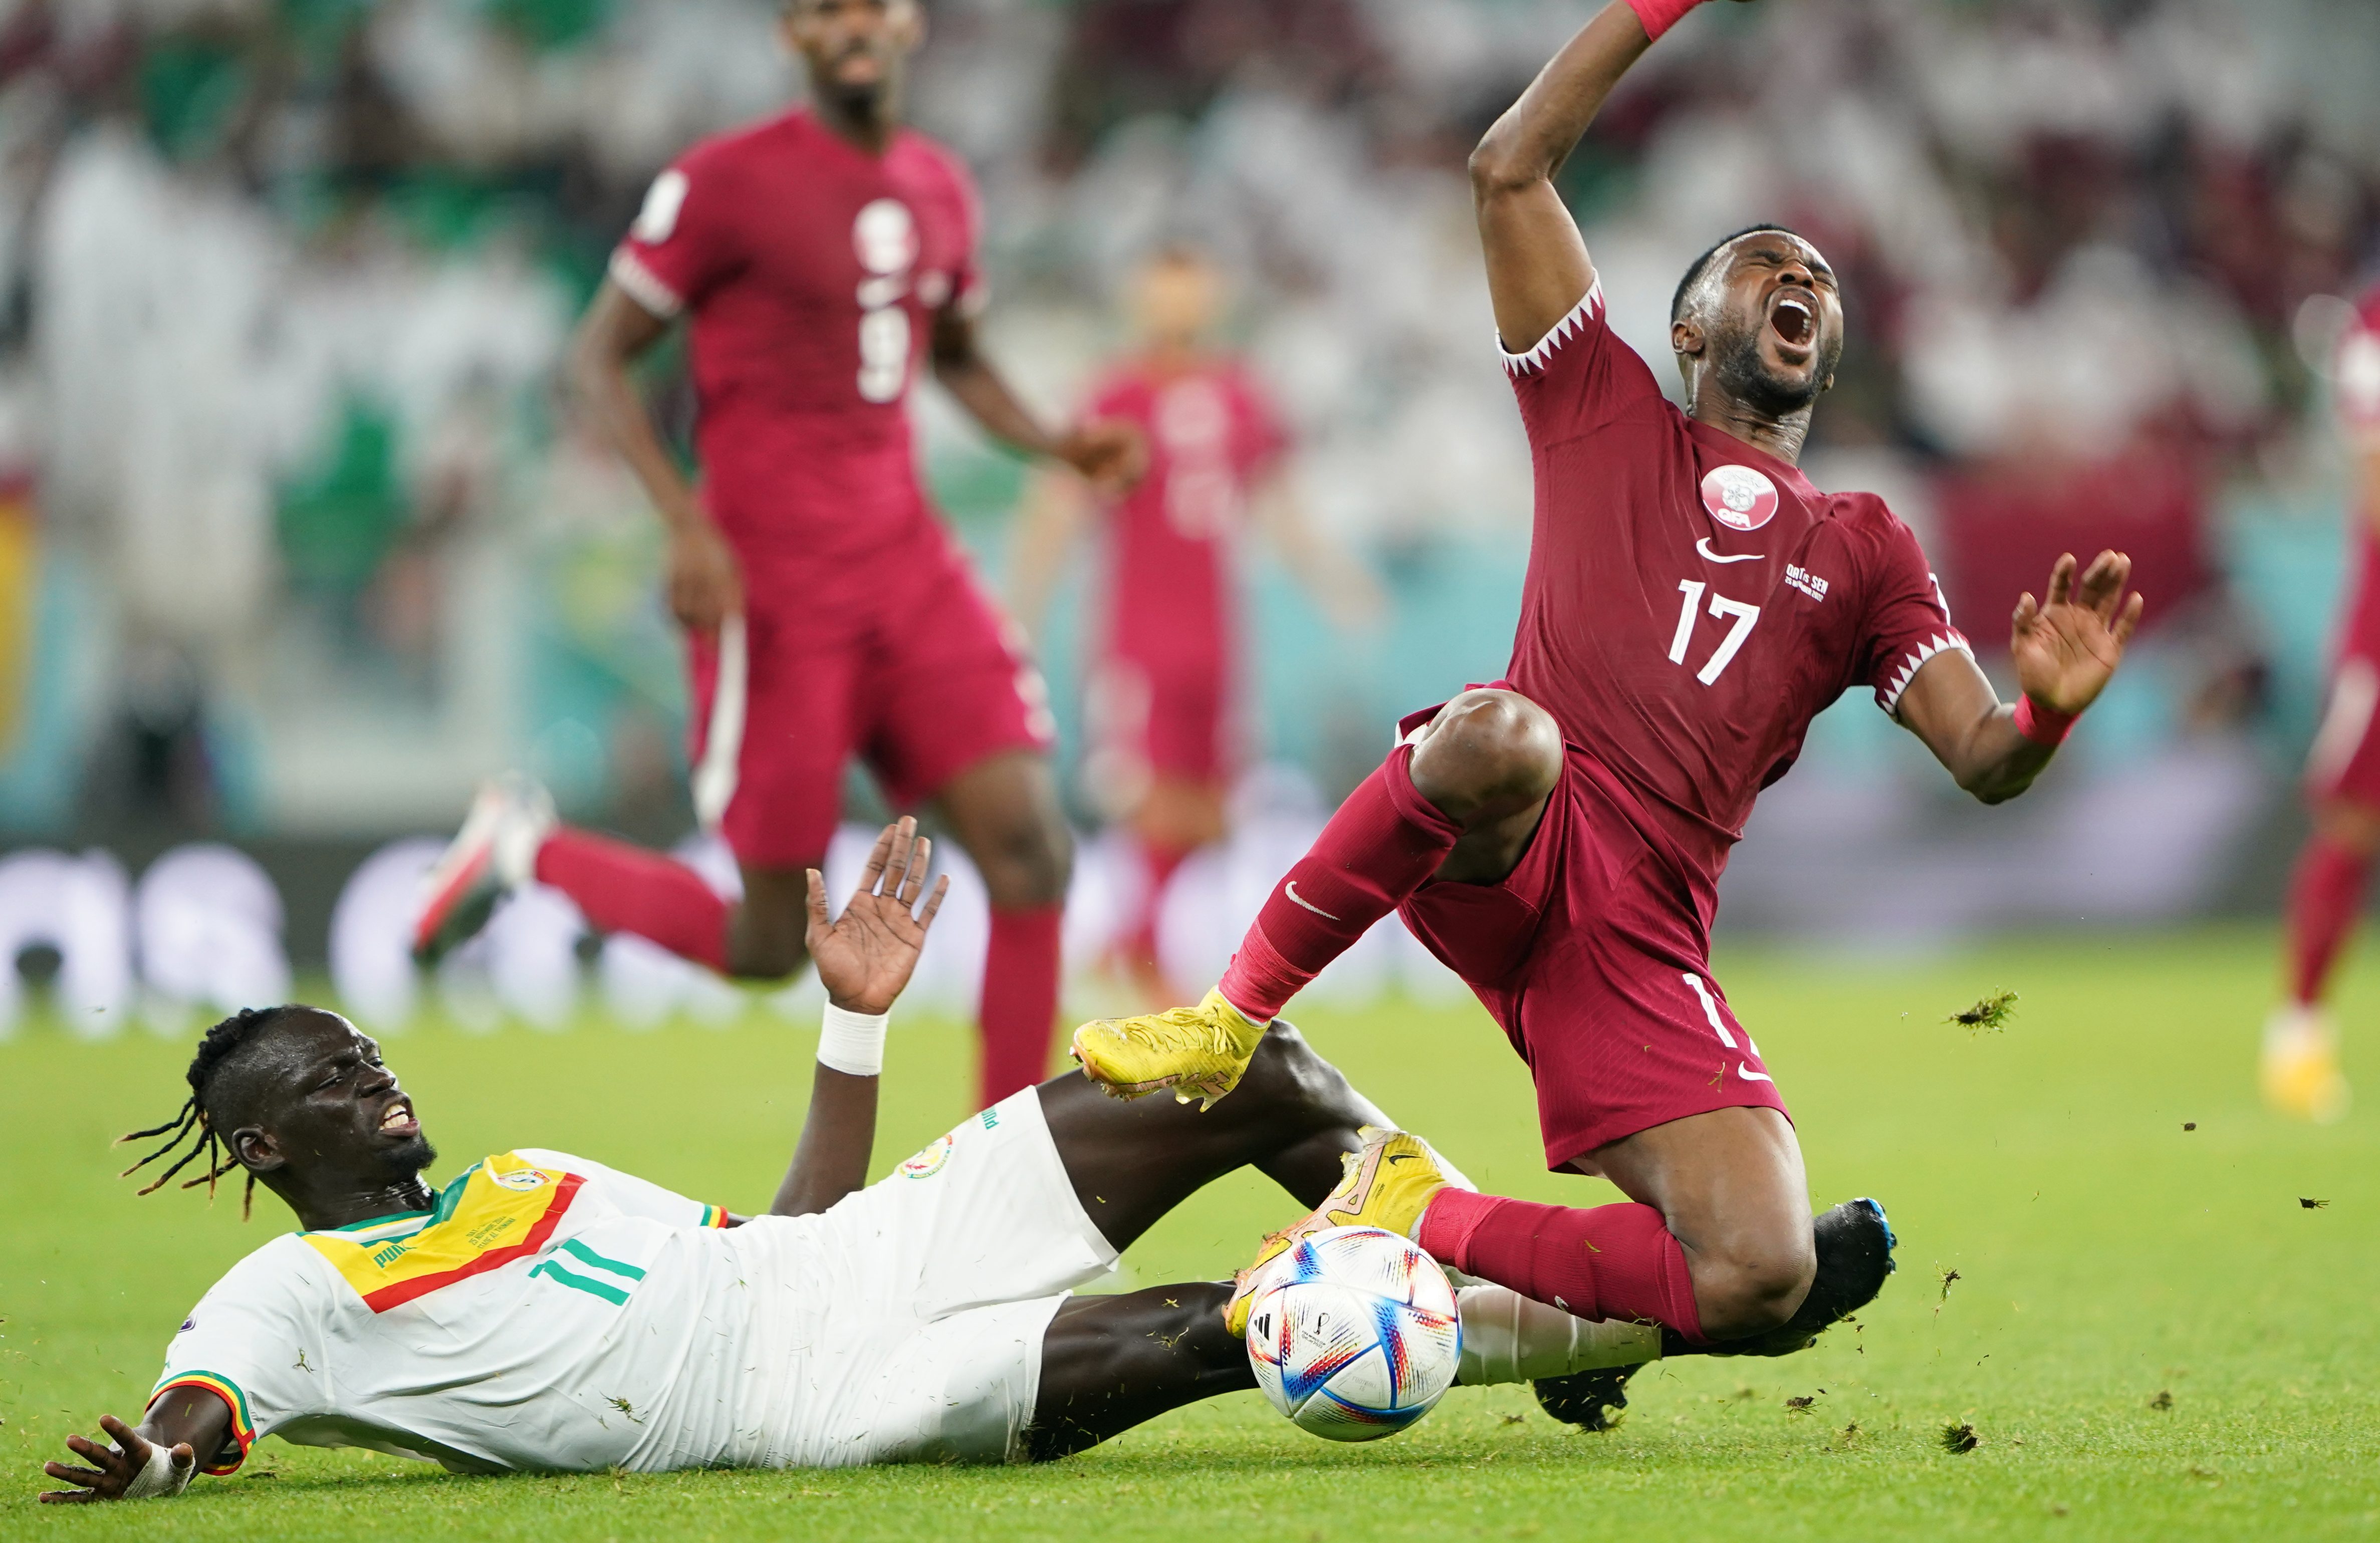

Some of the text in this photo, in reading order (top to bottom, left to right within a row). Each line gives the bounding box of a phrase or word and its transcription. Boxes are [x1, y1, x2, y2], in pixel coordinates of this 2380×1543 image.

[856, 303, 910, 402] 9
[1717, 507, 1751, 528] QFA
[1786, 563, 1806, 580] QAT
[1810, 575, 1829, 595] SEN
[1669, 579, 1761, 686] 17
[1682, 972, 1761, 1059] 1
[528, 1238, 647, 1307] 11
